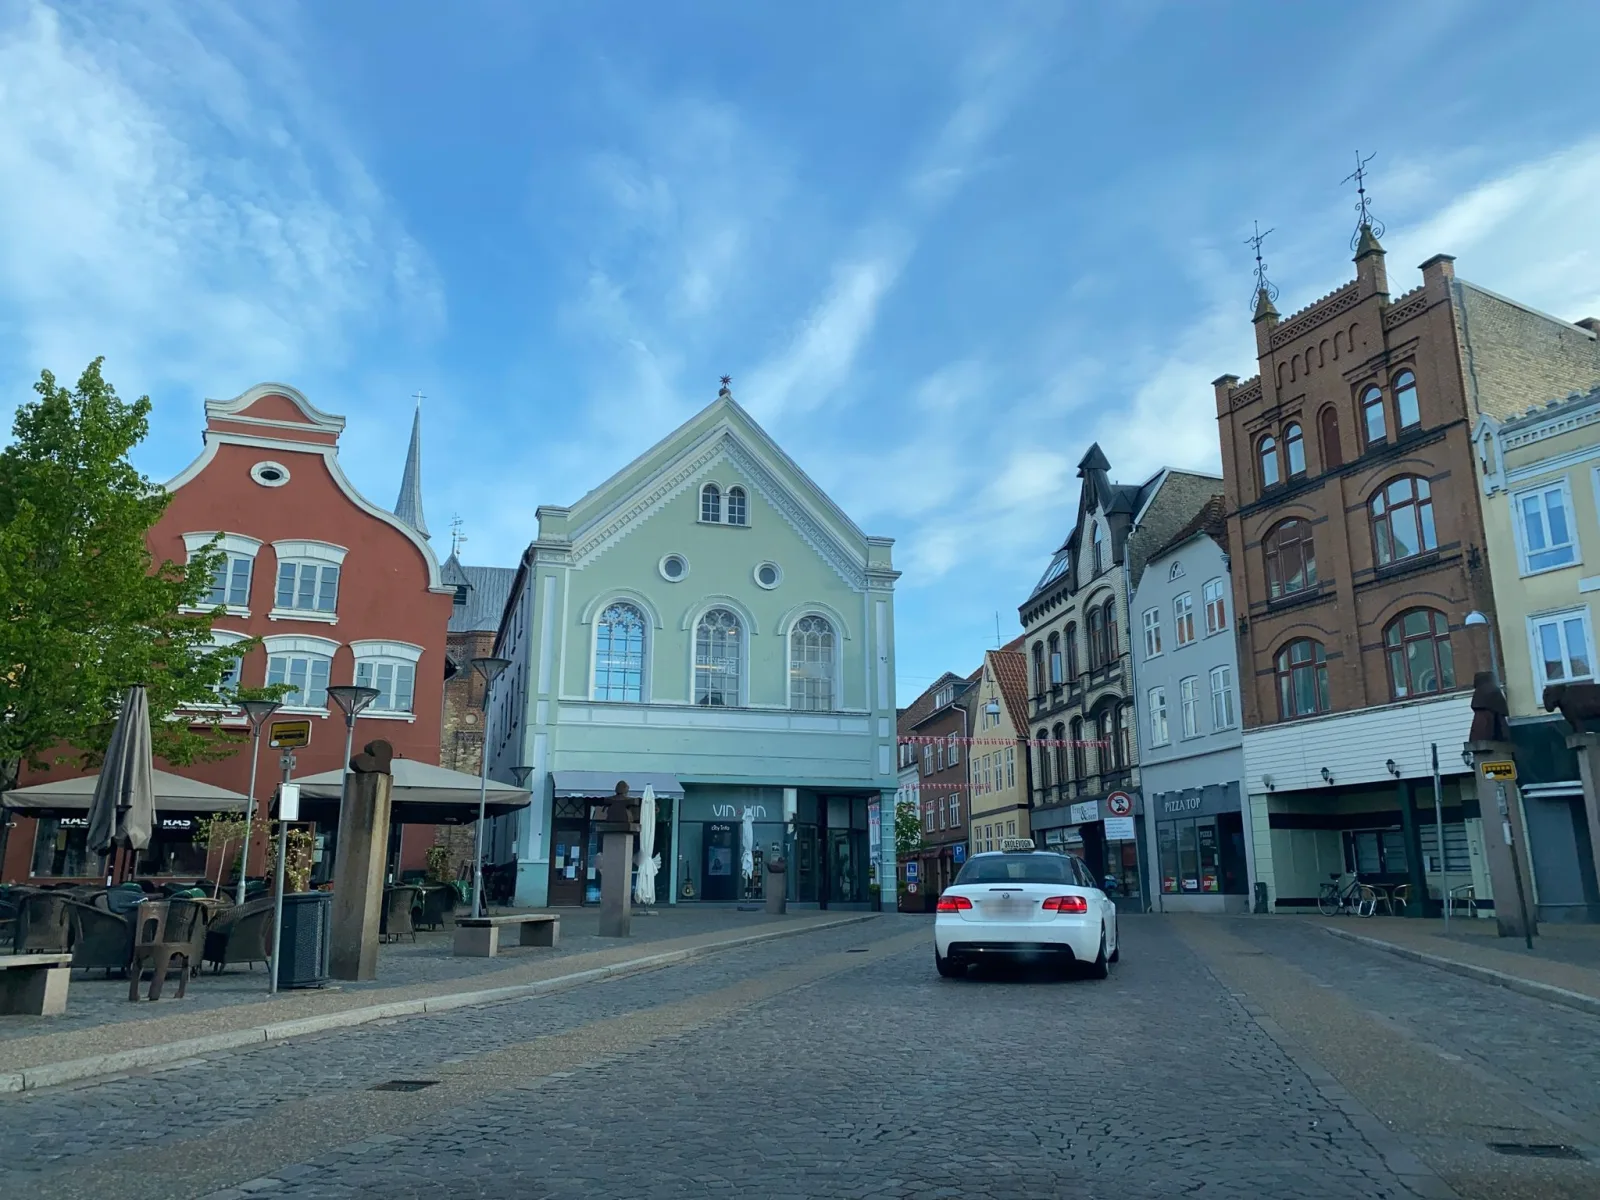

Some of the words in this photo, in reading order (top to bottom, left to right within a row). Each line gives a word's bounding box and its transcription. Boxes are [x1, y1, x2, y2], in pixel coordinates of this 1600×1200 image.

[1165, 800, 1185, 812] PIZZA
[1187, 798, 1200, 809] TOP
[956, 846, 962, 855] P
